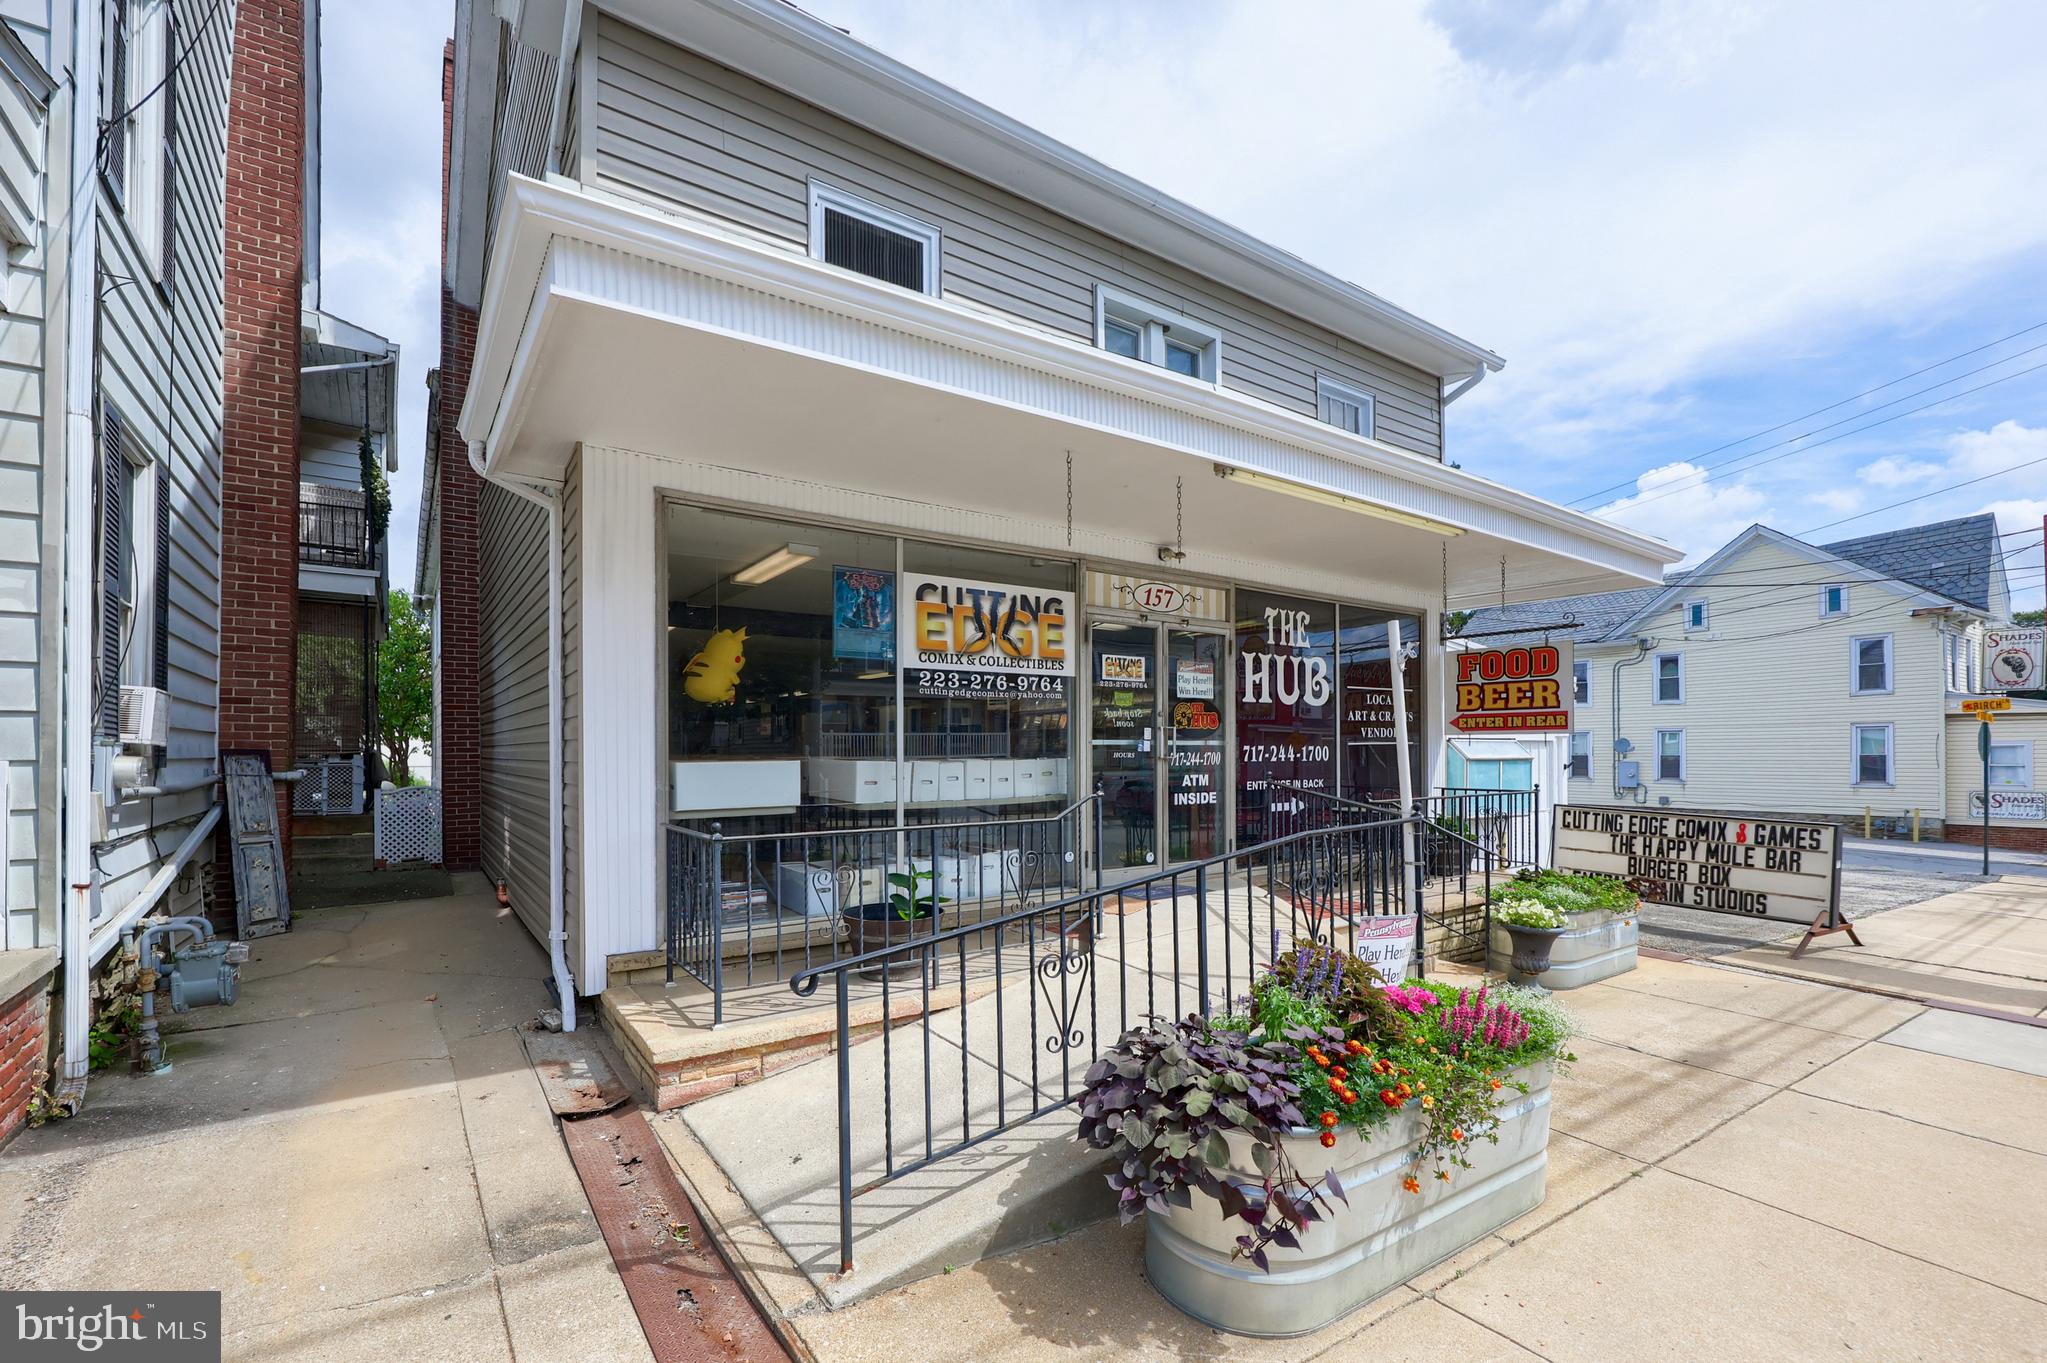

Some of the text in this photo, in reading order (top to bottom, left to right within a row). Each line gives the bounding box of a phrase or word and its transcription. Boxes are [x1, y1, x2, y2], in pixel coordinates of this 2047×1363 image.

[915, 583, 1064, 622] CUTTING
[1144, 587, 1174, 609] 157
[915, 600, 1065, 659] EDGE
[1264, 607, 1311, 648] THE
[1987, 633, 2042, 648] SHADES
[918, 652, 1065, 671] COMIX & COLLECTIBLES
[1457, 646, 1559, 682] FOOD
[919, 671, 1064, 692] 223-276-9764
[1178, 675, 1191, 685] Play
[1241, 651, 1330, 707] HUB
[1178, 687, 1191, 695] Win
[1366, 694, 1393, 705] LOCA
[1456, 679, 1561, 712] BEER
[1347, 710, 1368, 721] ART
[1369, 711, 1377, 721] &
[1973, 701, 2002, 711] BIRCH
[1458, 715, 1567, 728] ENTER IN REAR
[1243, 744, 1330, 762] 717-244-1700
[1182, 774, 1209, 787] ATM
[1293, 779, 1301, 788] IN
[1303, 779, 1325, 788] BACK
[1174, 792, 1217, 806] INSIDE
[1991, 794, 2044, 808] SHADES
[1562, 810, 1623, 833] CUTTING
[1629, 815, 1669, 838] EDGE
[1675, 819, 1728, 843] COMIX
[1753, 823, 1822, 850] GAMES
[1610, 834, 1637, 855] THE
[1705, 842, 1755, 868] MULE
[1765, 848, 1801, 872] BAR
[1628, 856, 1732, 887] BURGER BOX
[1693, 886, 1768, 915] STUDIOS
